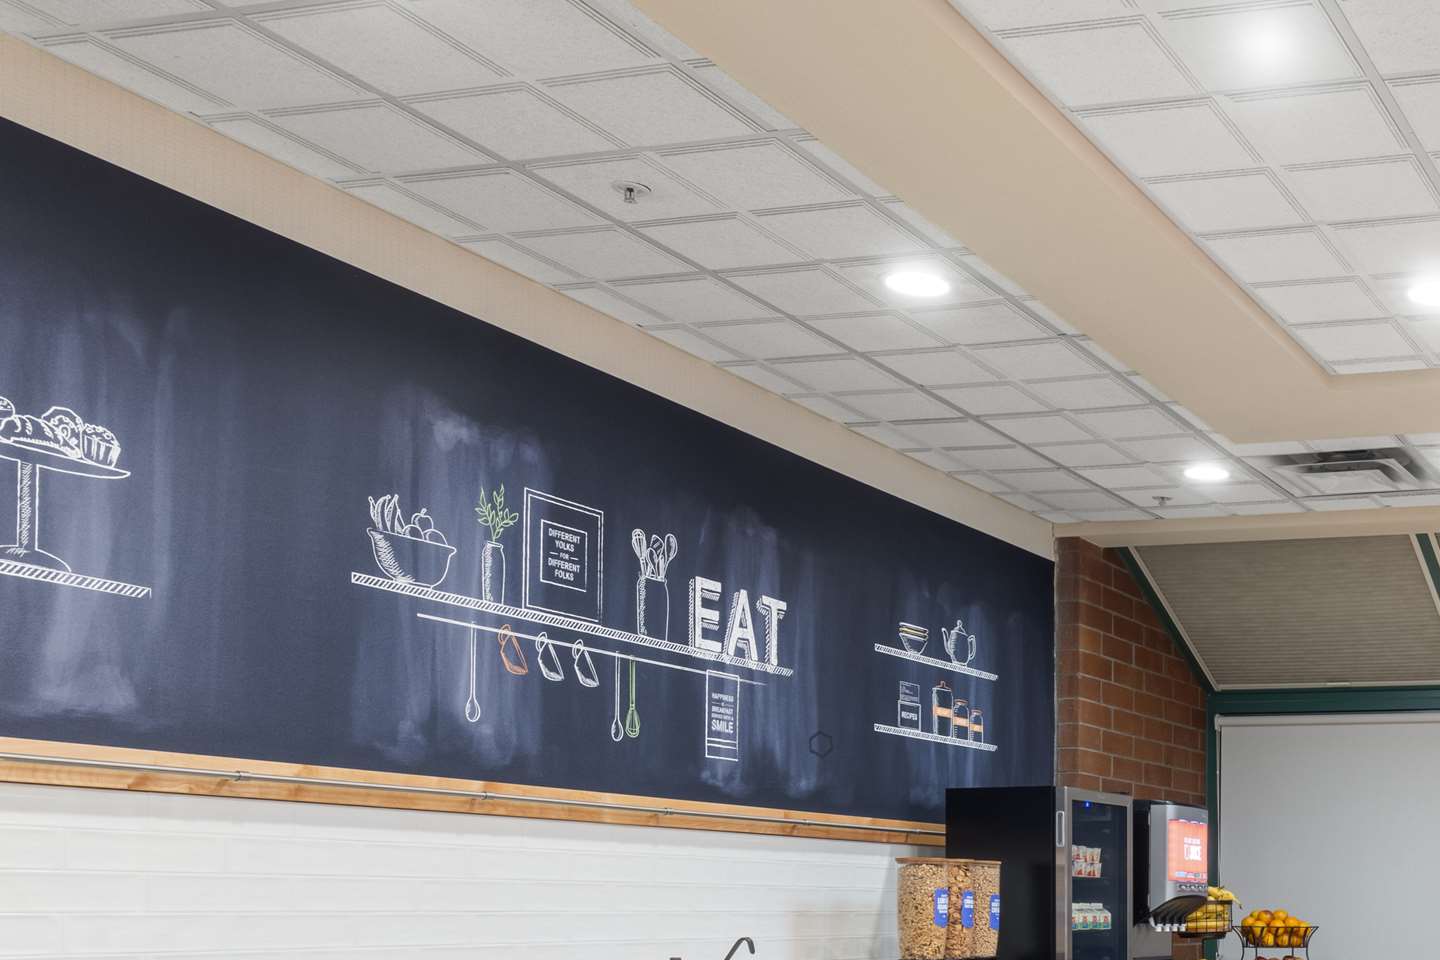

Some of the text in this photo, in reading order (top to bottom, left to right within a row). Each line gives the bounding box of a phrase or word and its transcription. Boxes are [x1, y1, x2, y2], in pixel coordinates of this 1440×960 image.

[548, 528, 580, 544] DIFFERENT
[555, 540, 574, 552] YOLKS
[548, 557, 580, 573] DIFFERENT
[554, 569, 574, 581] FOLKS
[689, 576, 787, 665] EAT
[711, 719, 734, 734] SMILE
